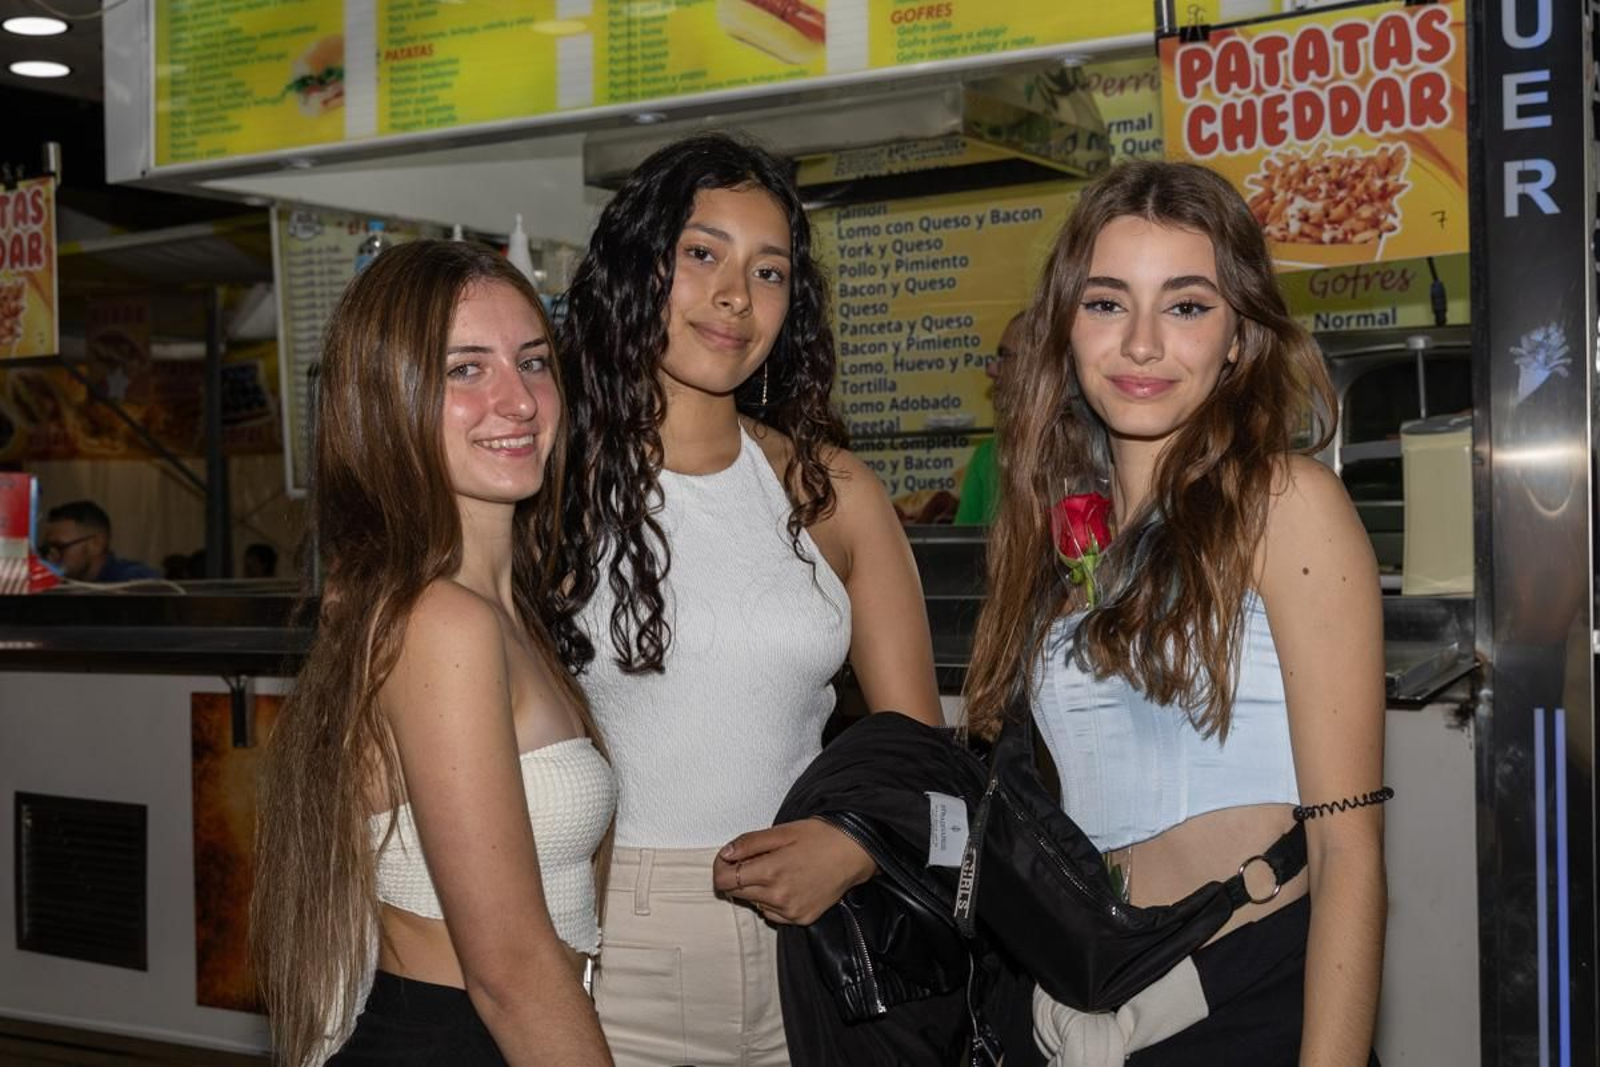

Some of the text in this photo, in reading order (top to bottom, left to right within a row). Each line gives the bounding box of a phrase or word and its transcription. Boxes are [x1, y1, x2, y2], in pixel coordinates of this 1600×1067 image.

[891, 2, 953, 24] GOFRES
[384, 43, 434, 62] PATATAS
[1178, 7, 1453, 100] PATATAS
[1186, 71, 1449, 157] CHEDDAR
[837, 207, 1042, 241] Lomo con Queso y Bacon
[838, 237, 943, 259] York y Queso
[838, 254, 969, 278] Pollo y Pimiento
[838, 275, 957, 299] Bacon y Queso
[1308, 264, 1416, 299] Gofres
[838, 301, 888, 319] Queso
[1313, 306, 1398, 330] Normal
[839, 314, 973, 336] Panceta y Queso
[840, 332, 981, 357] Bacon y Pimiento
[840, 360, 888, 376] Lomo,
[893, 355, 945, 373] Huevo
[949, 355, 958, 371] y
[840, 376, 897, 395] Tortilla
[841, 393, 961, 415] Lomo Adobado
[891, 434, 969, 453] Completo
[890, 459, 899, 475] y
[904, 455, 954, 471] Bacon
[904, 474, 956, 492] Queso
